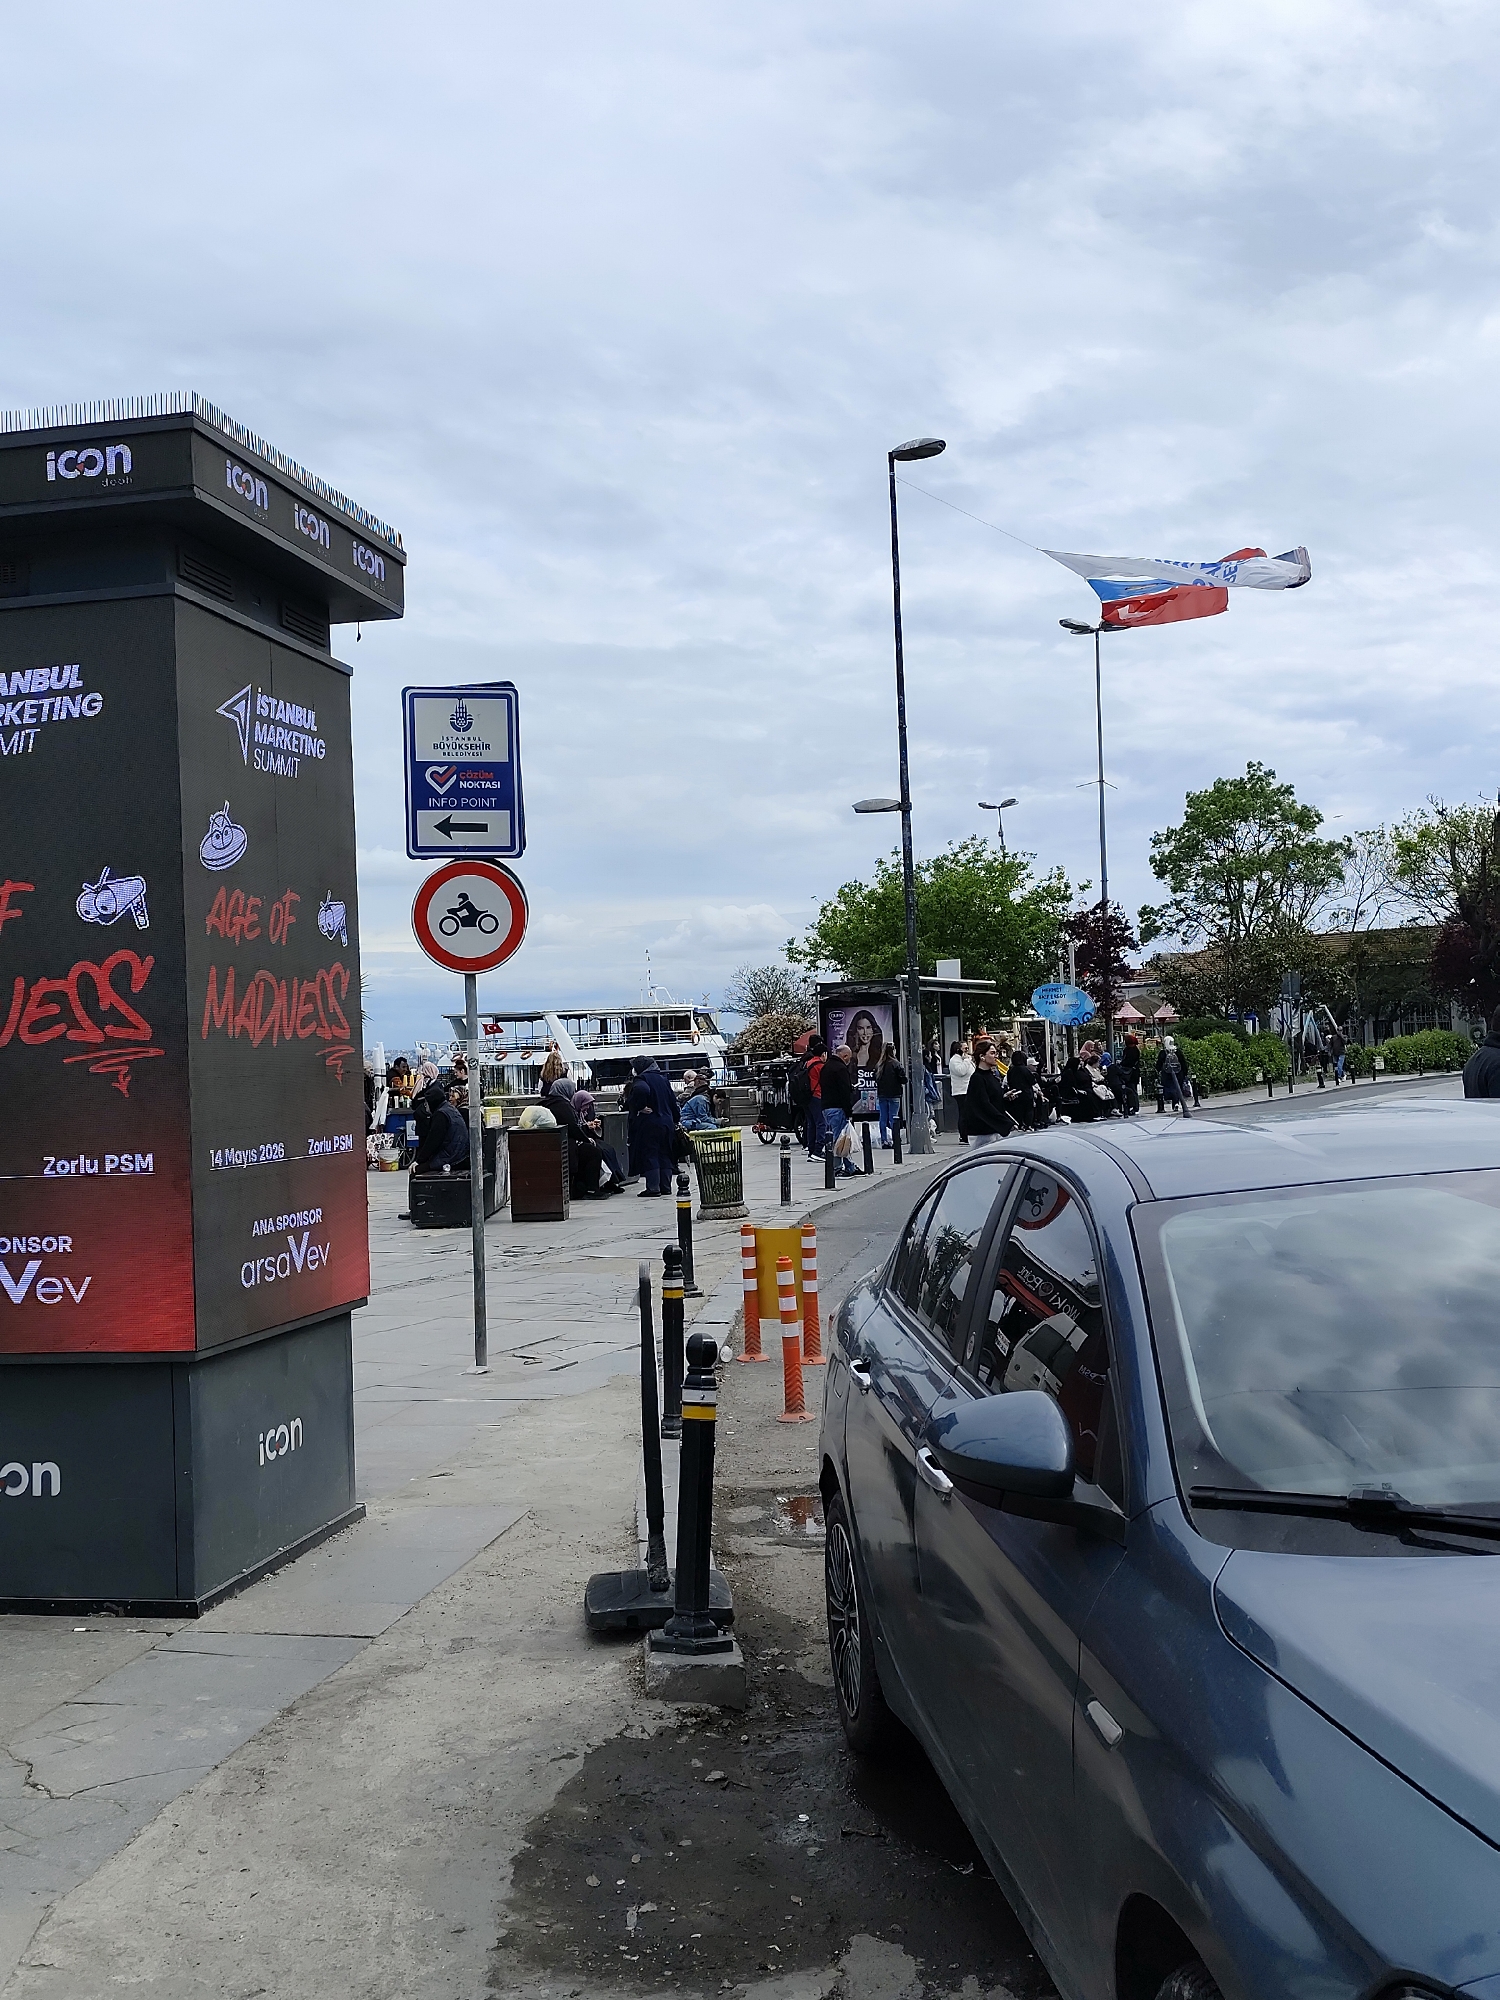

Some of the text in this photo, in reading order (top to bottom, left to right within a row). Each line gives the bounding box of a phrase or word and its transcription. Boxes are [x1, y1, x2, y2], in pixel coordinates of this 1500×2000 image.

[46, 443, 132, 482] icon
[225, 459, 269, 511] icon
[294, 503, 330, 549] icon
[352, 541, 385, 582] icon
[254, 721, 326, 760] MARKETING
[253, 748, 301, 778] SUMMIT
[459, 770, 494, 780] ÇÖZÜM
[428, 797, 497, 808] INFO POINT
[459, 780, 501, 789] NOKTASI
[205, 885, 262, 946] AGE
[268, 887, 301, 946] OF
[201, 961, 351, 1049] MADNESS
[209, 1142, 285, 1168] 14 Mayıs 2026
[307, 1133, 353, 1155] Zorlu PSM
[43, 1152, 154, 1175] Zorlu PSM
[252, 1207, 323, 1237] ANA SPONSOR
[258, 1416, 304, 1466] icon
[0, 1461, 61, 1497] on
